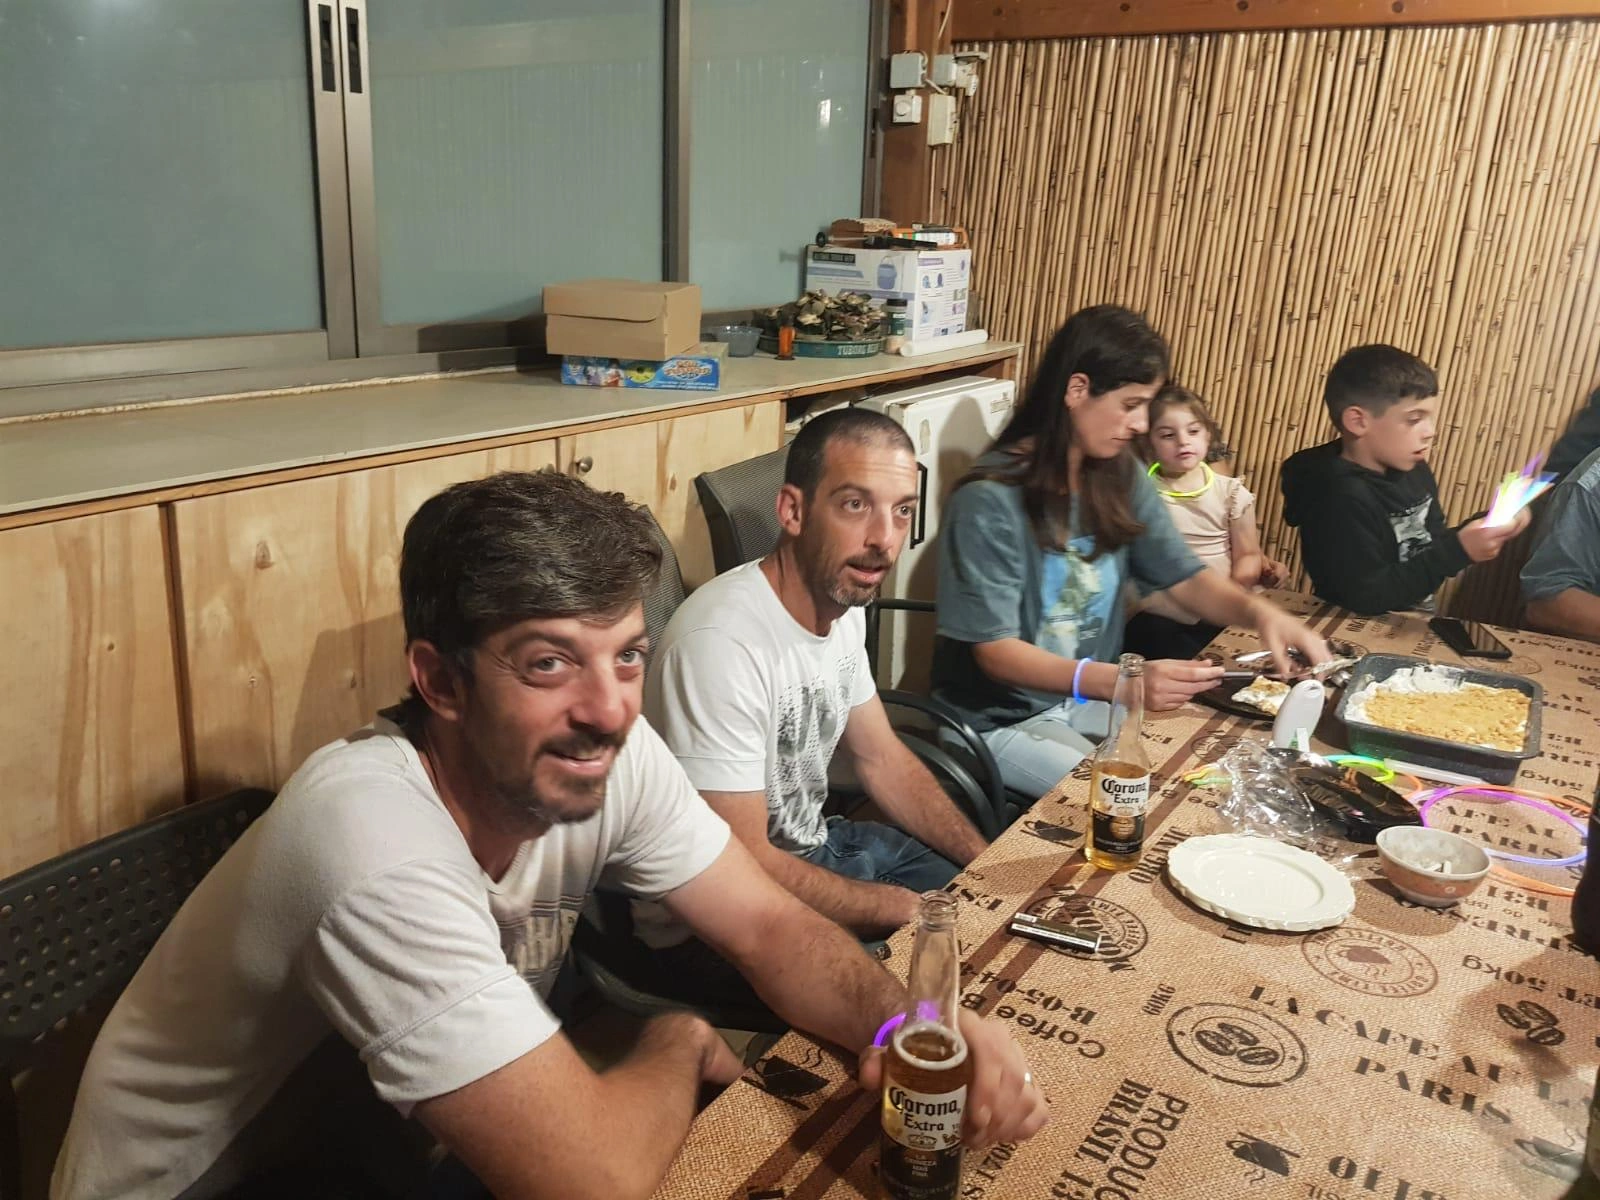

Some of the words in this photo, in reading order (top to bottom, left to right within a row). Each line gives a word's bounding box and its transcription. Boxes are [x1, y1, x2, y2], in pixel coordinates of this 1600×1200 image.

[1462, 954, 1547, 993] 50kg
[996, 1005, 1106, 1059] Coffee
[888, 1086, 958, 1116] Corona
[1354, 1056, 1512, 1124] PARIS
[903, 1112, 945, 1131] Extra
[1075, 1078, 1153, 1164] BRASIL
